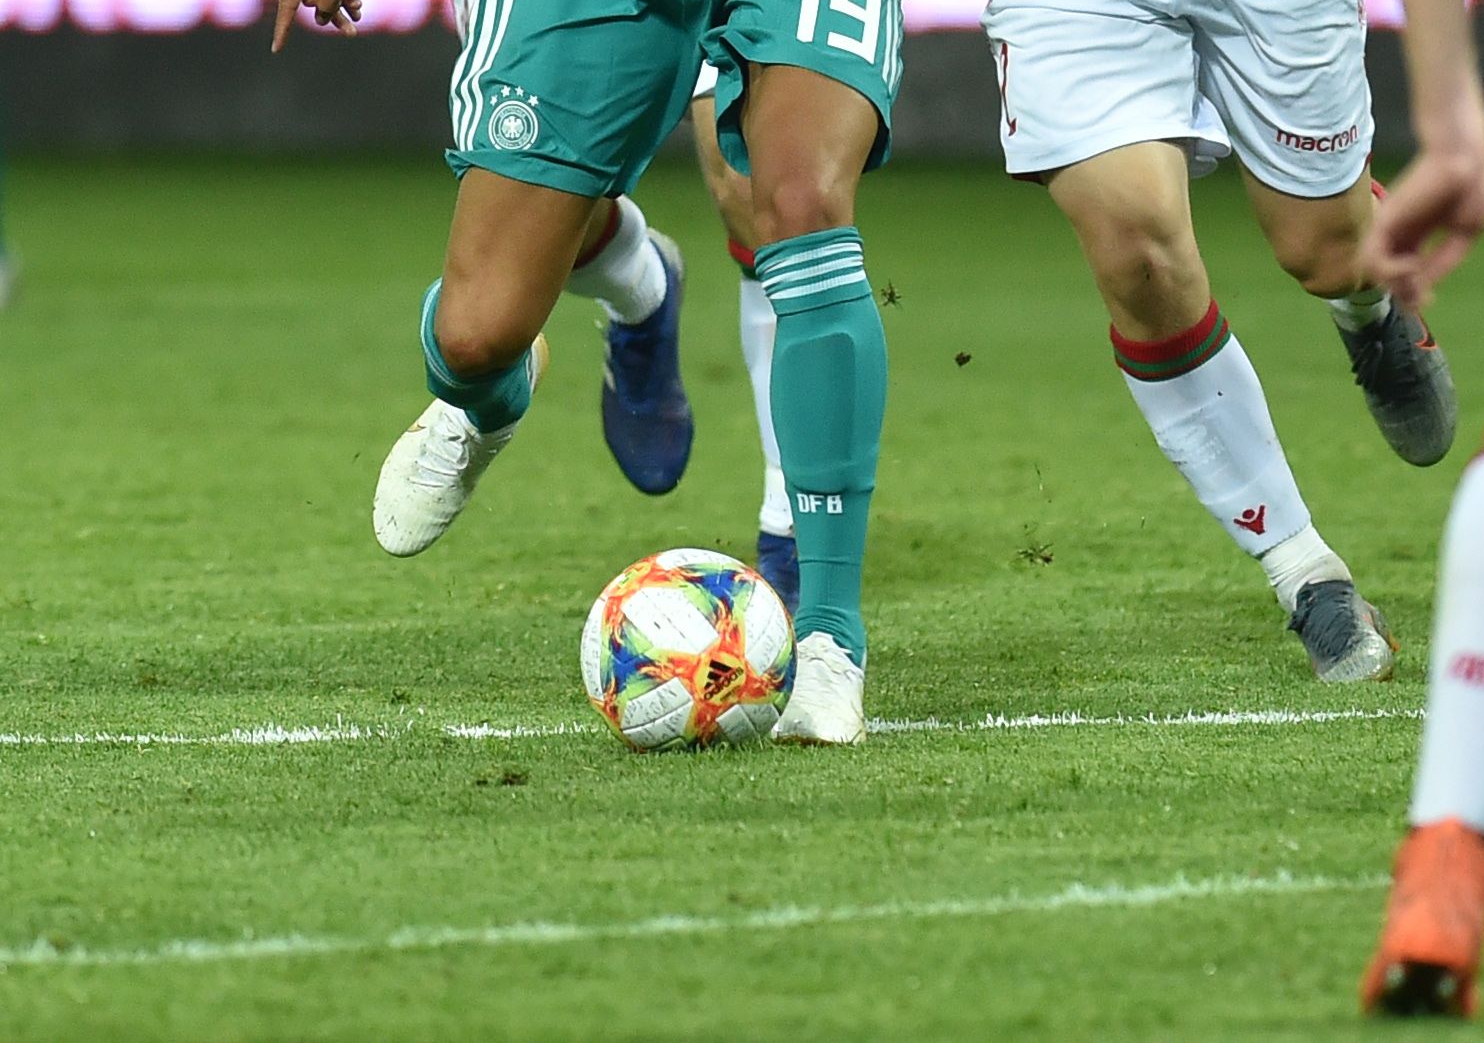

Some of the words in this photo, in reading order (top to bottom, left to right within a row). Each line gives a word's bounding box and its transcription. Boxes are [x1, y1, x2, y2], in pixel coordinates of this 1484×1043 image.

[1276, 124, 1358, 152] macron
[796, 492, 843, 514] DFB
[703, 665, 744, 701] adidas
